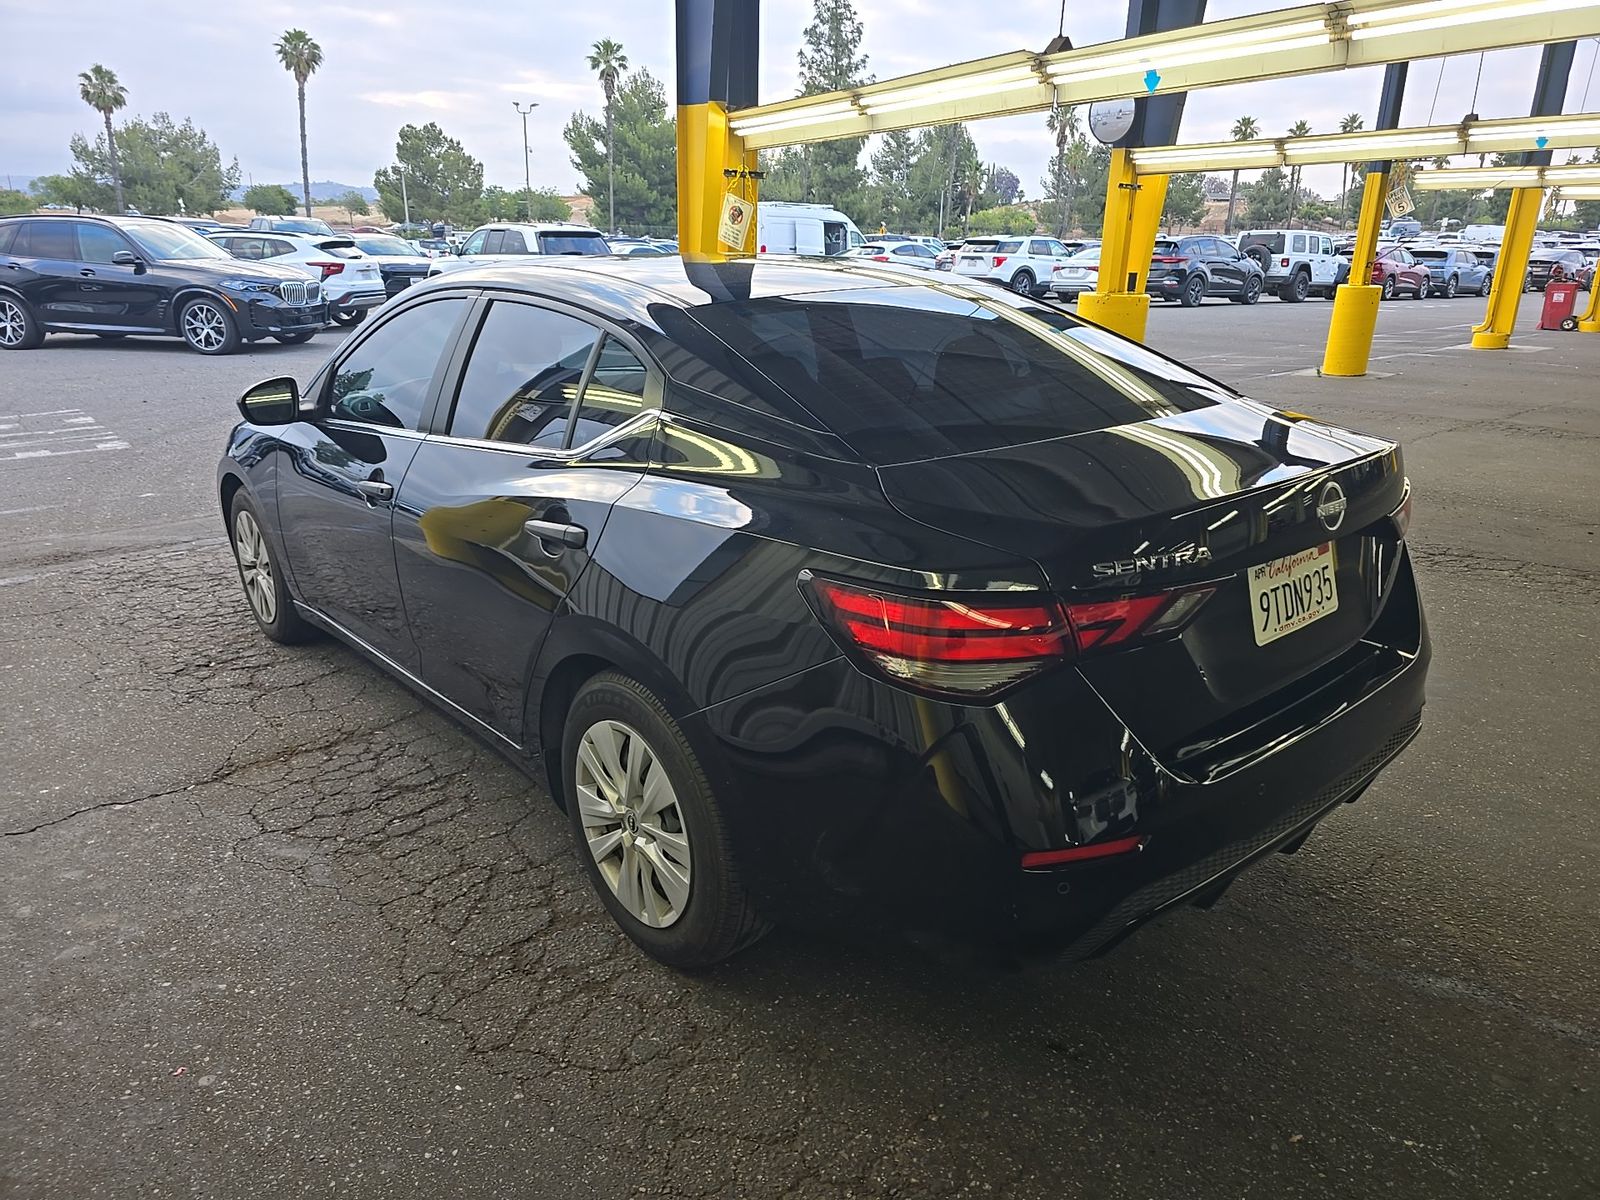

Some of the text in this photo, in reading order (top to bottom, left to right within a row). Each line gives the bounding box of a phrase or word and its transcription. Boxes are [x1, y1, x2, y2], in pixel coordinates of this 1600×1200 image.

[1397, 202, 1405, 212] 5
[1092, 546, 1213, 578] SENTRA
[1254, 551, 1320, 581] APR California
[1259, 564, 1333, 633] 9TDN935
[1278, 608, 1321, 632] dmv.ca.gov
